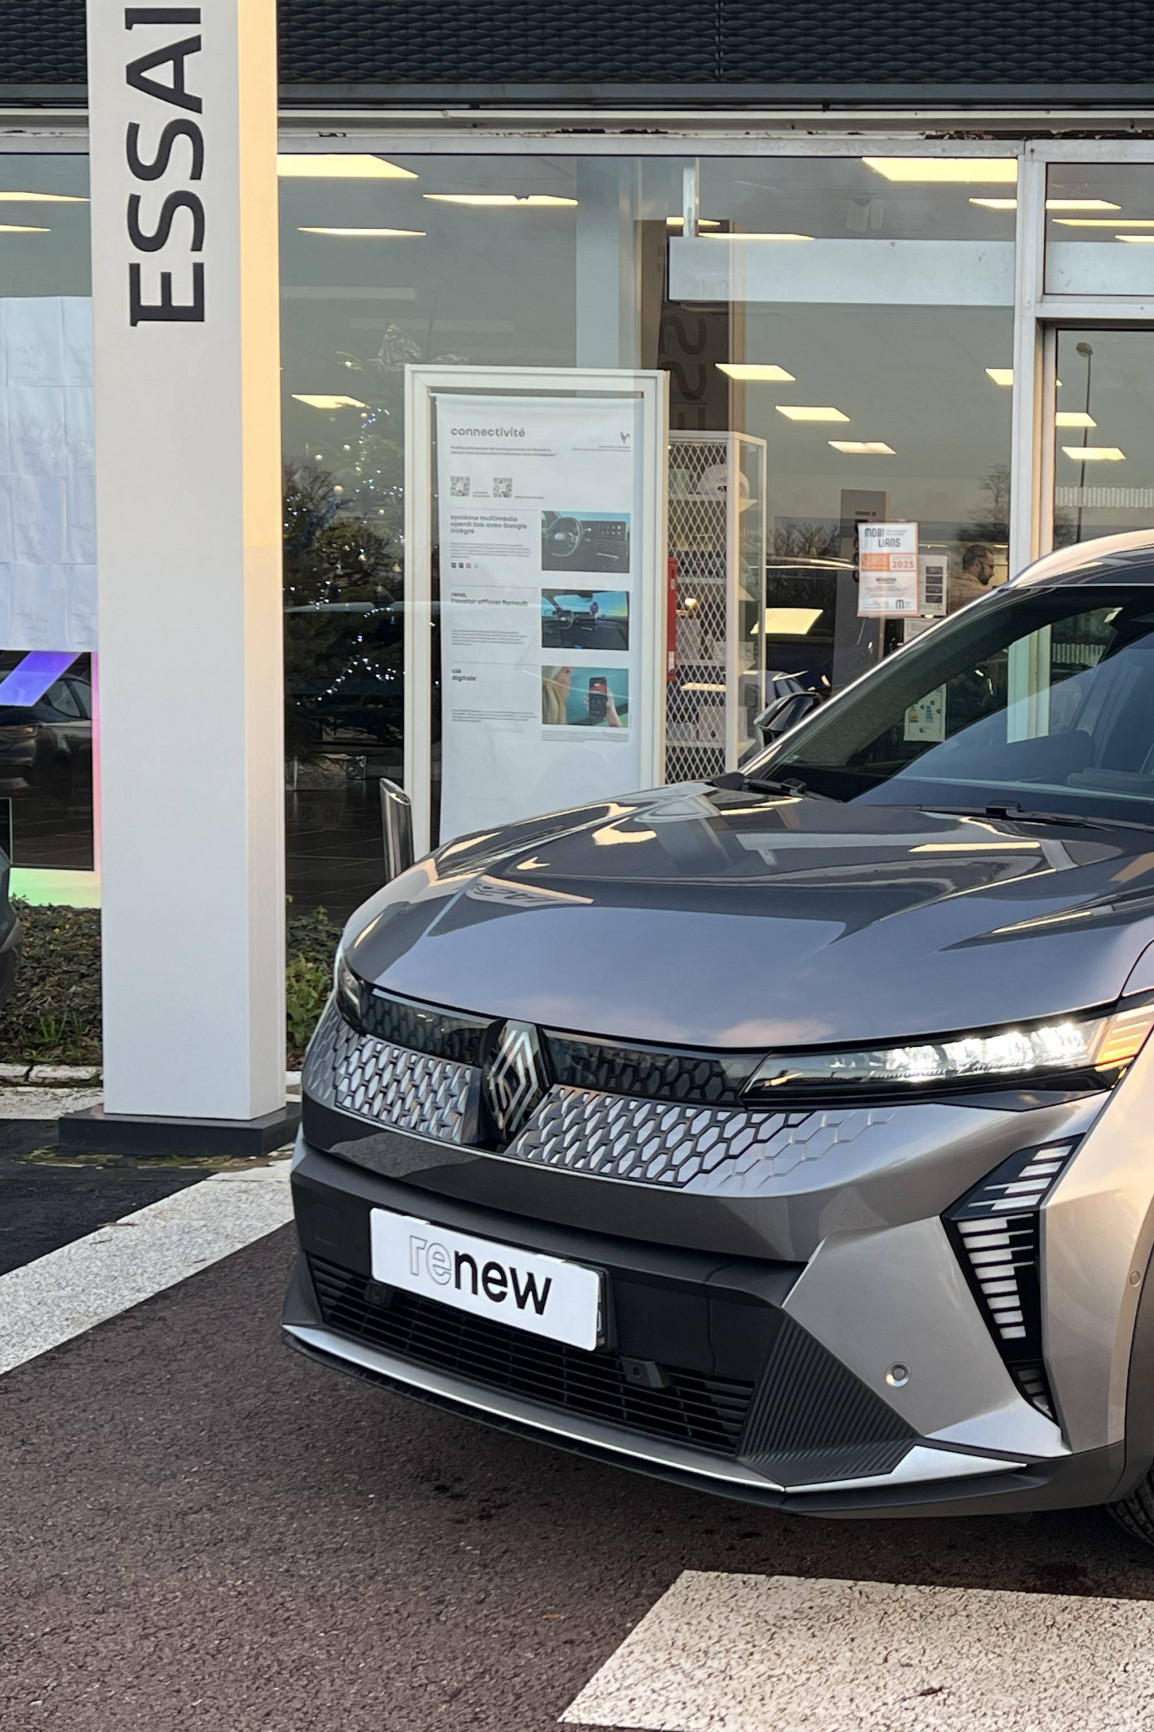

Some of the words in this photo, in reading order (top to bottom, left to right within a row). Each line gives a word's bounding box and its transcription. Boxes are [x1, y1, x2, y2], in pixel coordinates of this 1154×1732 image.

[125, 7, 206, 327] ESSAI
[450, 426, 526, 438] connectivité
[891, 560, 915, 569] 2025
[408, 1234, 553, 1316] renew
